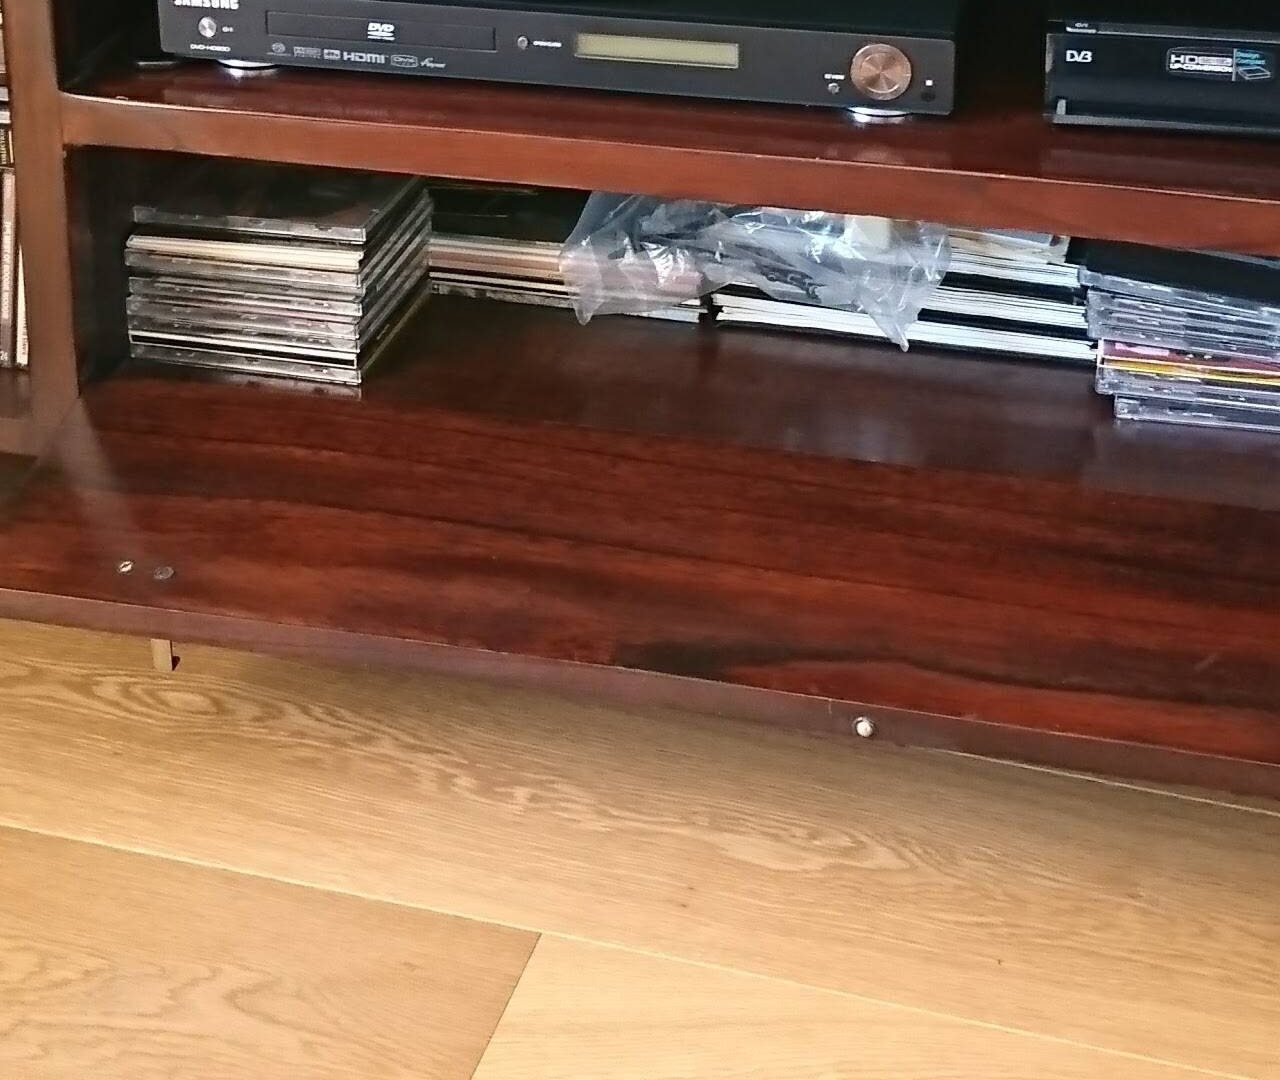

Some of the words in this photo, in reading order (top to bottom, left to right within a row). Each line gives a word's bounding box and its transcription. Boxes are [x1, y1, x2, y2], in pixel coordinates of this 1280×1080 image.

[368, 22, 395, 35] DVD
[343, 51, 386, 64] HDMI
[1066, 50, 1092, 63] DVB
[1170, 54, 1198, 64] HD
